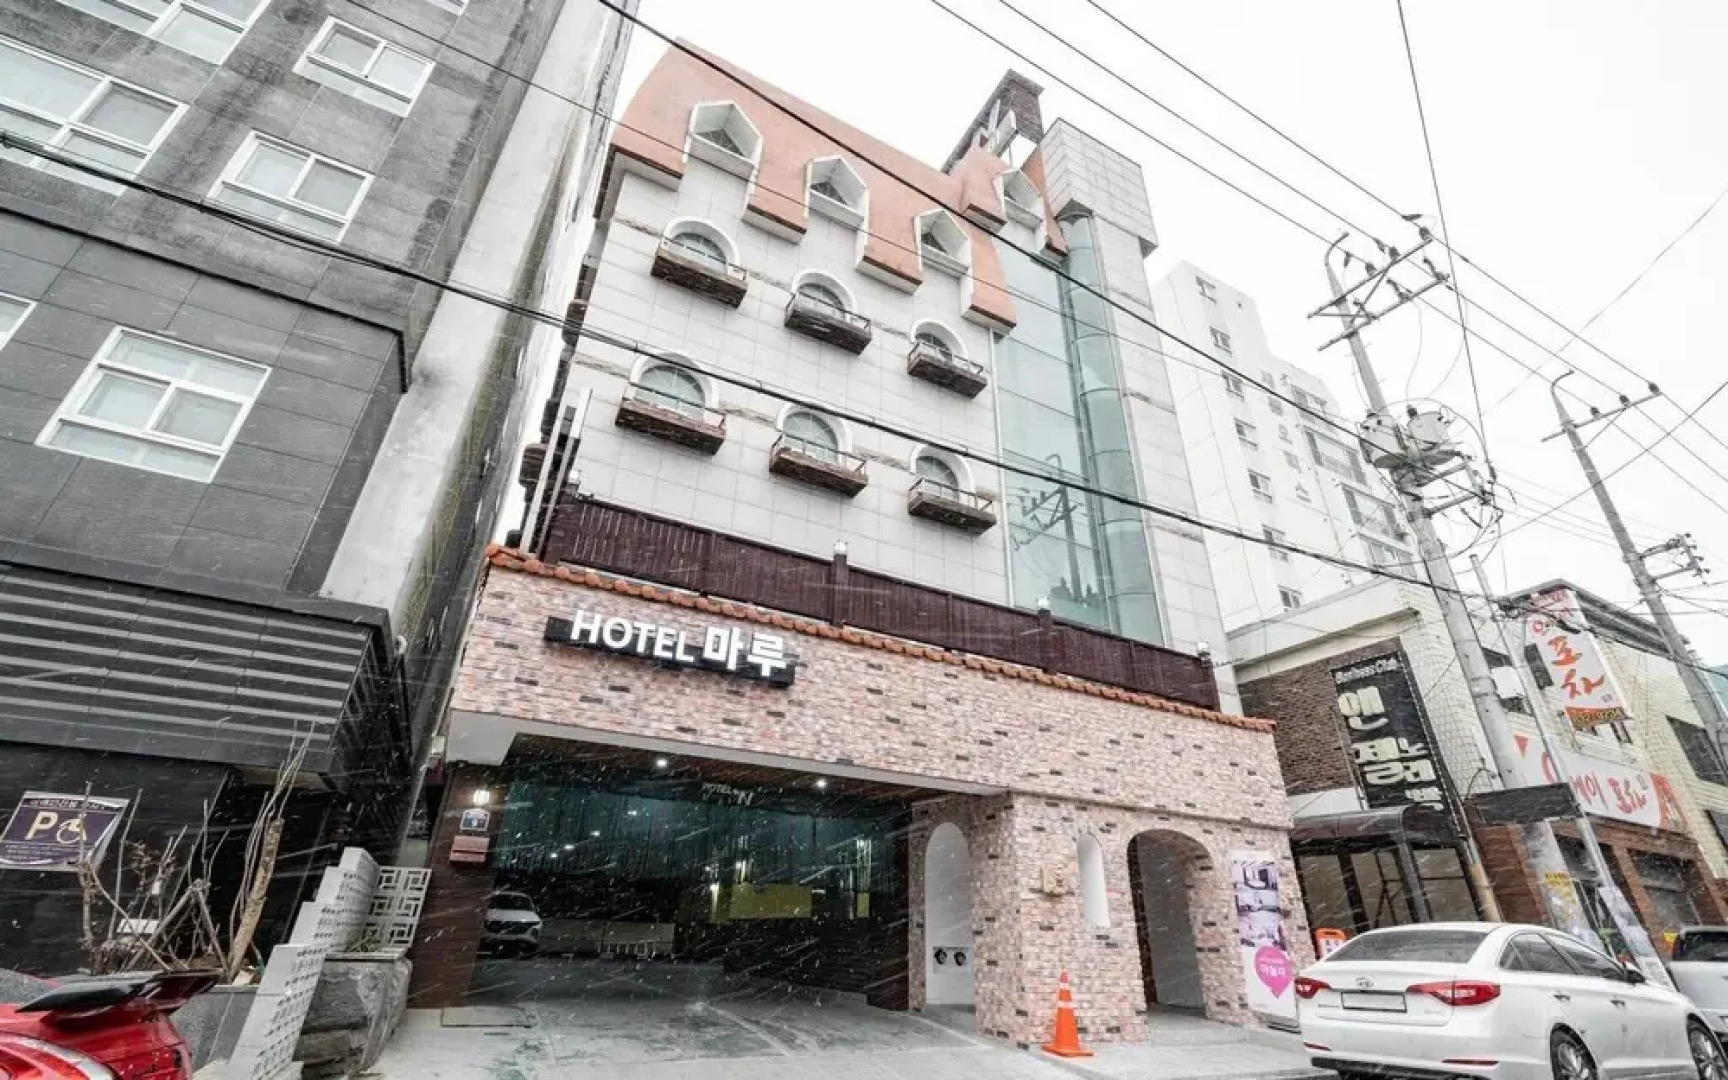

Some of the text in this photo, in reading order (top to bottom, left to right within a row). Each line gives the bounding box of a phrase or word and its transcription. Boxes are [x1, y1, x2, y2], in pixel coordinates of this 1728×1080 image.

[570, 609, 787, 677] HOTEL 마루
[25, 811, 59, 840] P
